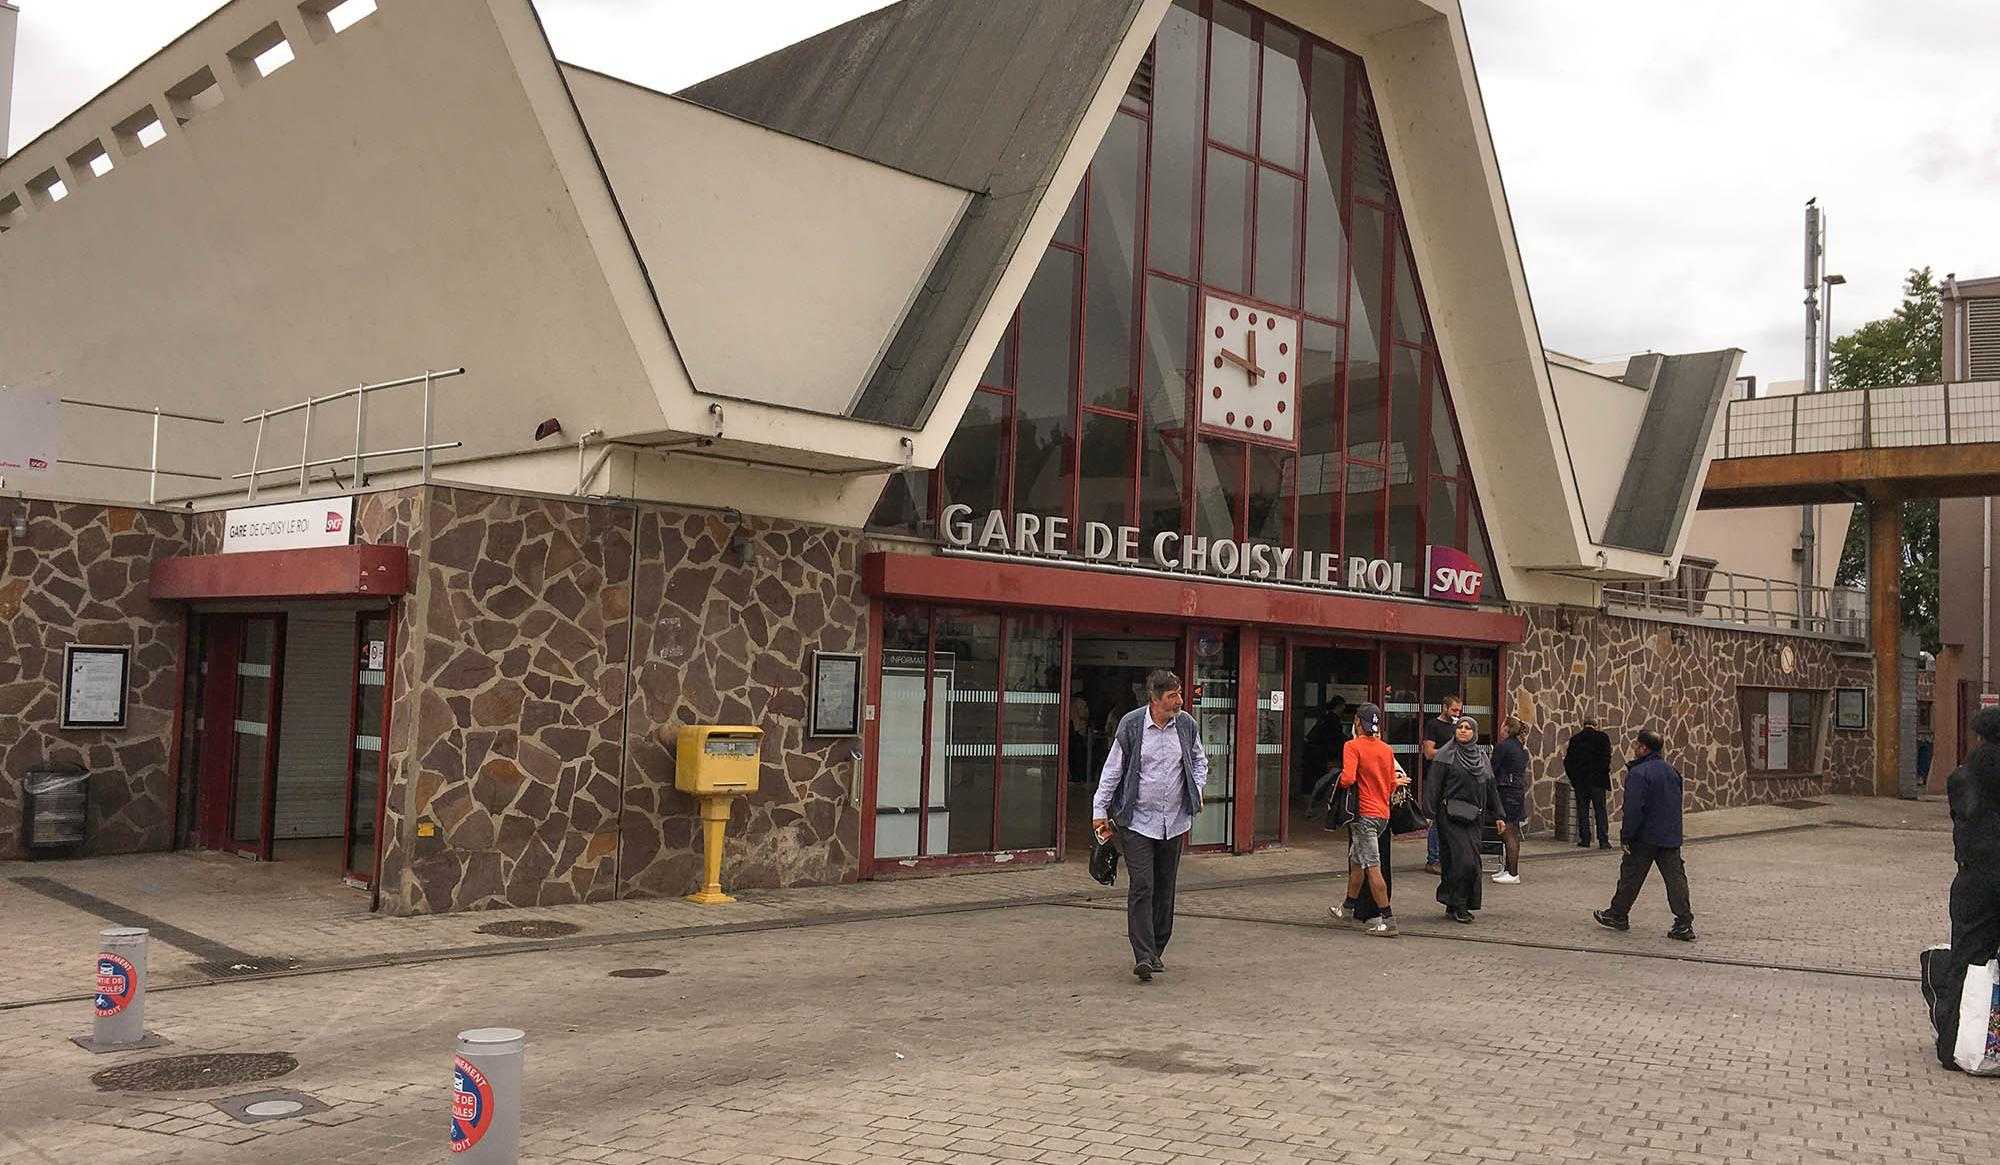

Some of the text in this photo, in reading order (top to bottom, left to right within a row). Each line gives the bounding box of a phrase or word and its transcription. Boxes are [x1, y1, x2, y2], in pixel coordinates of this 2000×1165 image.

[230, 519, 309, 538] GARE DE CHOISY LE ROI
[941, 503, 1402, 593] GARE DE CHOISY LE ROI
[1432, 567, 1483, 594] SNCF
[461, 1095, 473, 1105] DE
